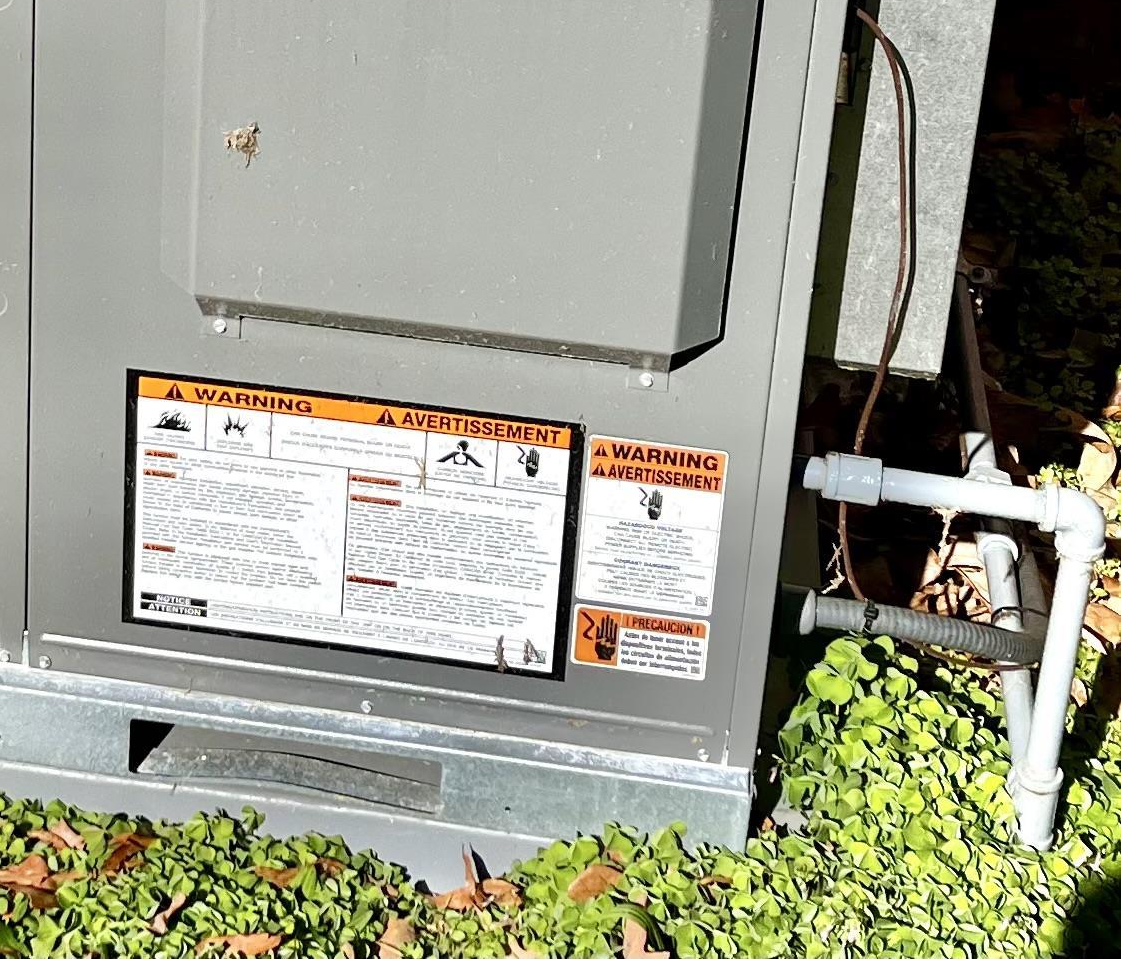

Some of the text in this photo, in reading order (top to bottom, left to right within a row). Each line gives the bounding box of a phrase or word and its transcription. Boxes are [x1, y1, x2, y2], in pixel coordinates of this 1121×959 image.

[194, 386, 313, 414] WARNING
[401, 410, 562, 445] AVERTISSEMENT
[611, 442, 719, 472] WARNING
[607, 463, 722, 491] AVERTISSEMENT
[147, 602, 202, 617] ATTENTION
[156, 593, 192, 606] NOTICE
